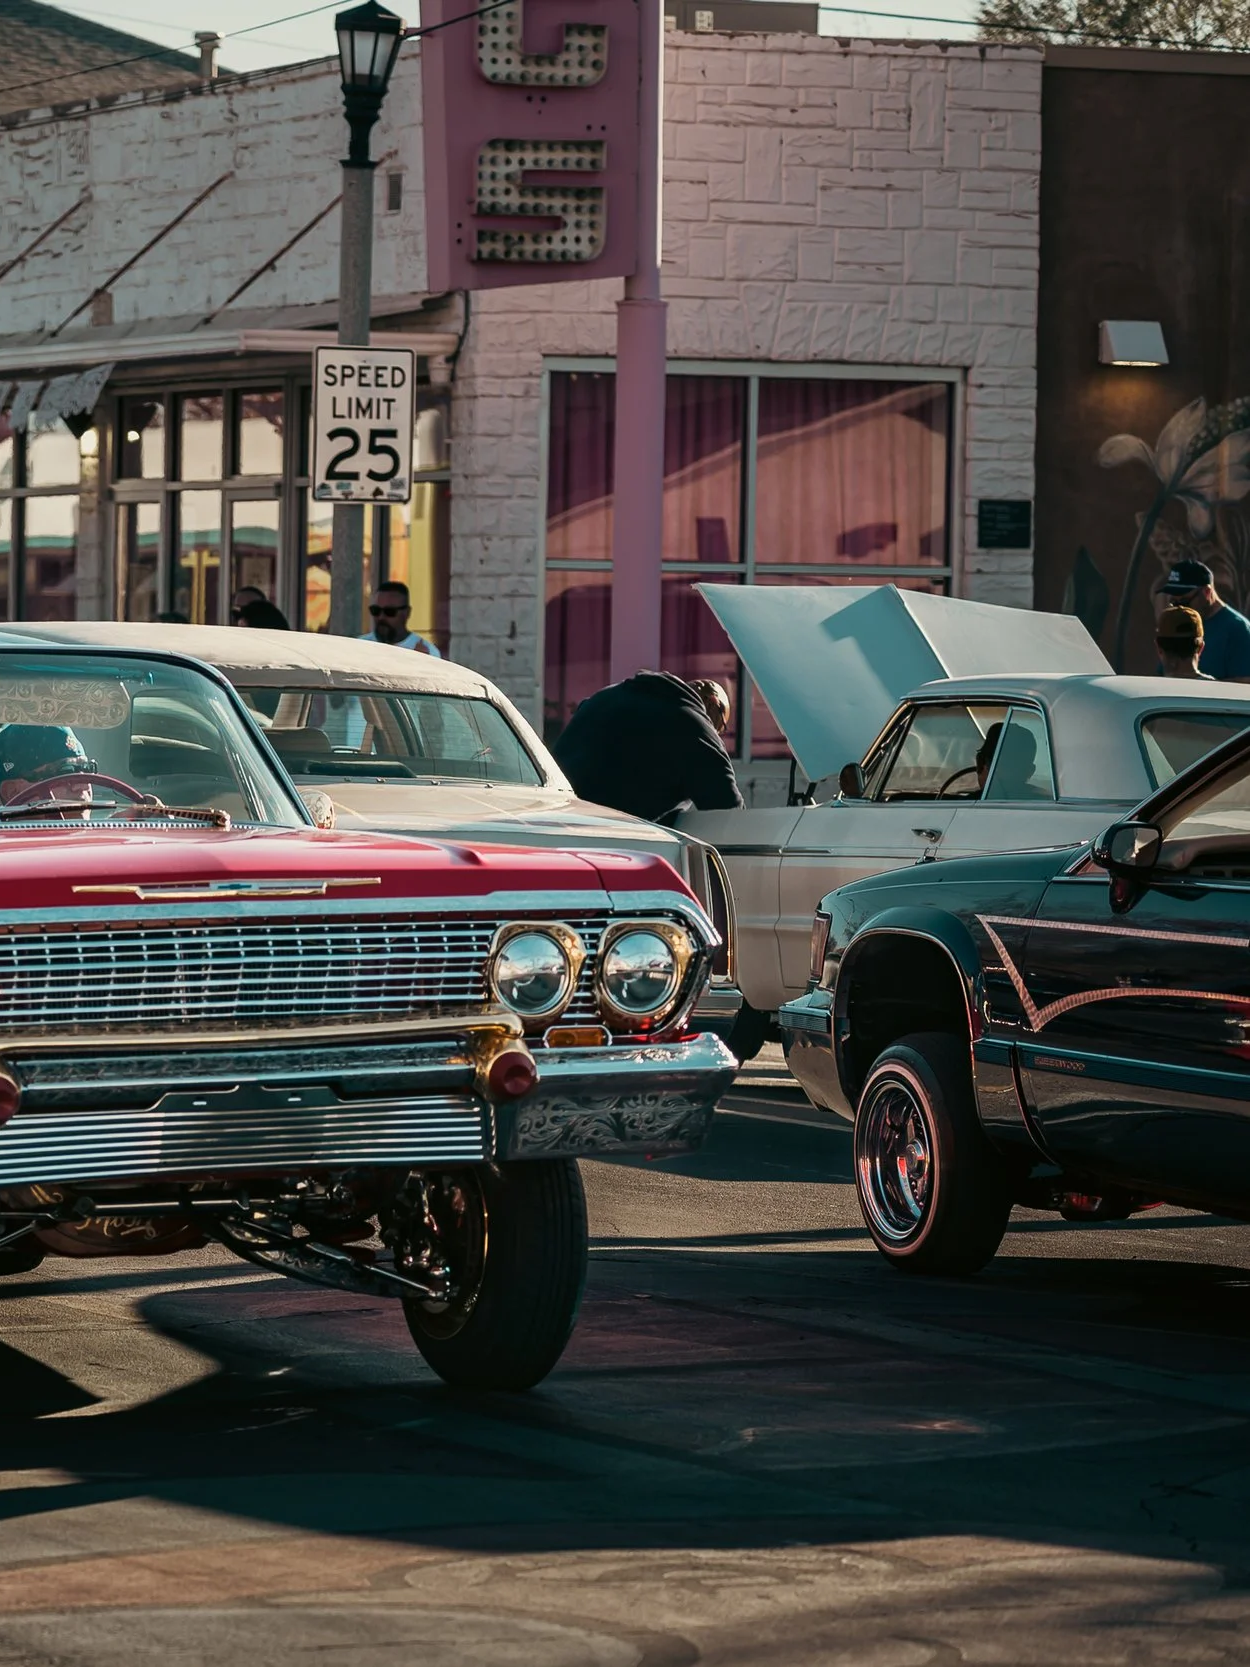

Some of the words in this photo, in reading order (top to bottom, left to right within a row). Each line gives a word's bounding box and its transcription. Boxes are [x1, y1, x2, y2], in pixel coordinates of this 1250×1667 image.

[323, 364, 406, 388] SPEED
[332, 396, 397, 420] LIMIT
[325, 427, 401, 482] 25
